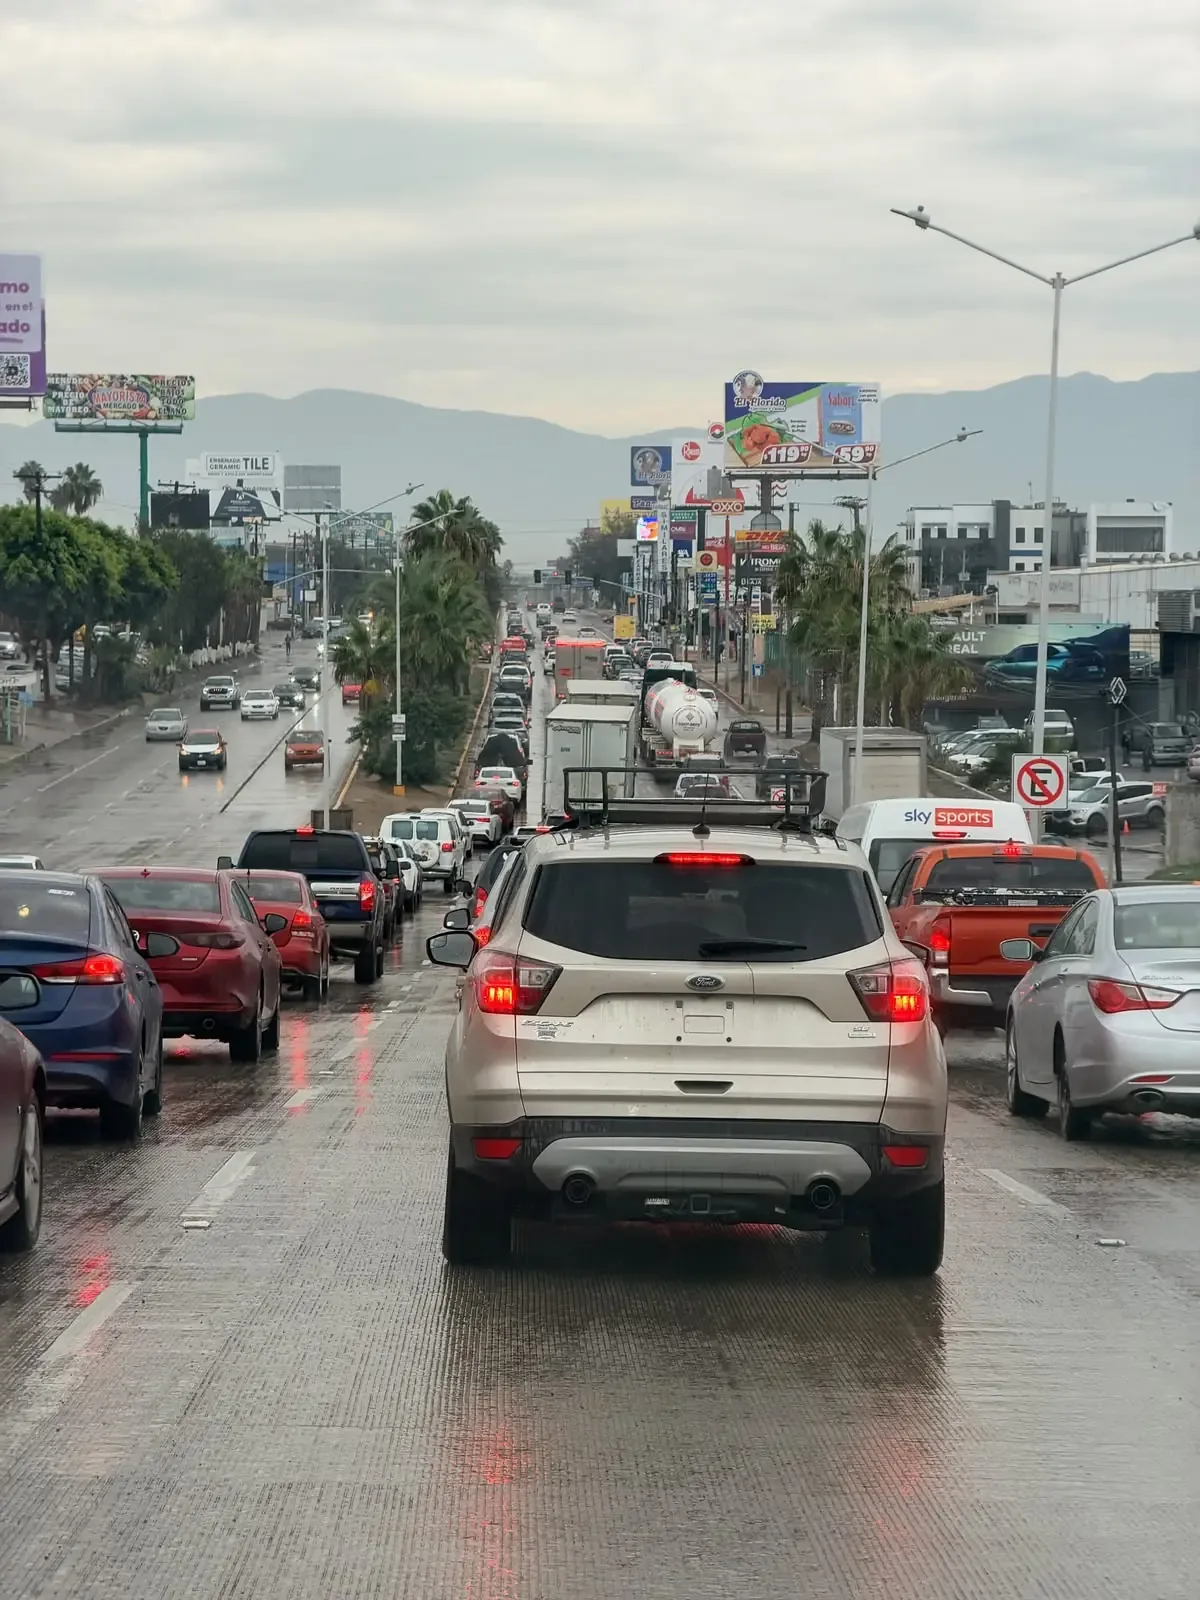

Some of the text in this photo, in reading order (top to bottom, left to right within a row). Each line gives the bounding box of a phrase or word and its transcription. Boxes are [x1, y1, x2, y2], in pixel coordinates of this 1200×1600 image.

[154, 379, 191, 387] PRECIOS
[92, 391, 147, 404] MAYORISTA
[750, 398, 785, 406] Florido
[102, 402, 137, 410] MERCADO
[243, 457, 269, 470] TILE
[712, 503, 742, 512] OXXO
[660, 511, 668, 571] SIMILARES
[905, 809, 932, 824] sky
[937, 811, 990, 824] sports
[695, 976, 716, 986] Ford
